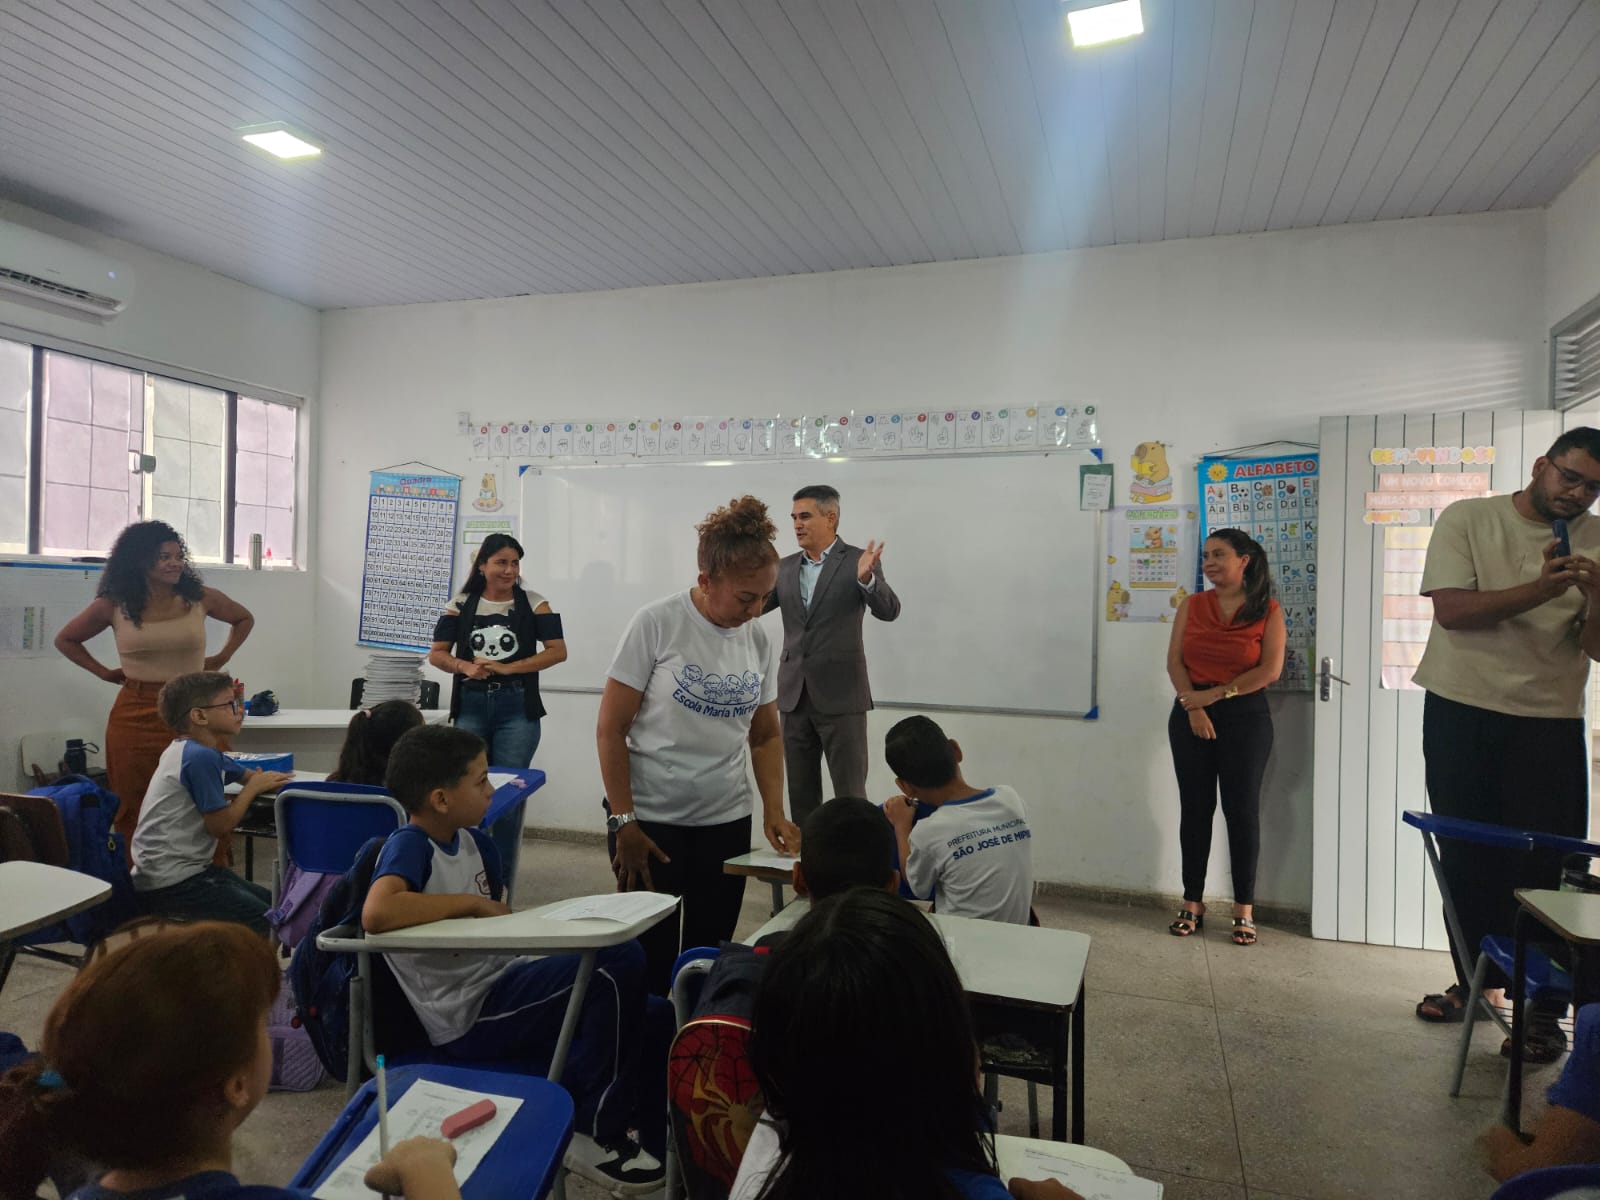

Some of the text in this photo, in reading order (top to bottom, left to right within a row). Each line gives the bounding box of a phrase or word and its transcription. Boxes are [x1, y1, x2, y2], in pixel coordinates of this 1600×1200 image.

[1234, 460, 1316, 478] ALFABETO
[1207, 478, 1310, 494] A B C D E
[1305, 498, 1311, 506] E
[1281, 523, 1287, 532] J
[1305, 521, 1313, 530] K
[1282, 563, 1316, 575] P Q
[1285, 608, 1293, 617] V
[1288, 651, 1295, 660] Z
[672, 688, 702, 712] Escola
[947, 828, 992, 848] PREFEITURA
[952, 846, 974, 860] SÃO
[976, 836, 1000, 851] JOSÉ
[1000, 834, 1013, 844] DE
